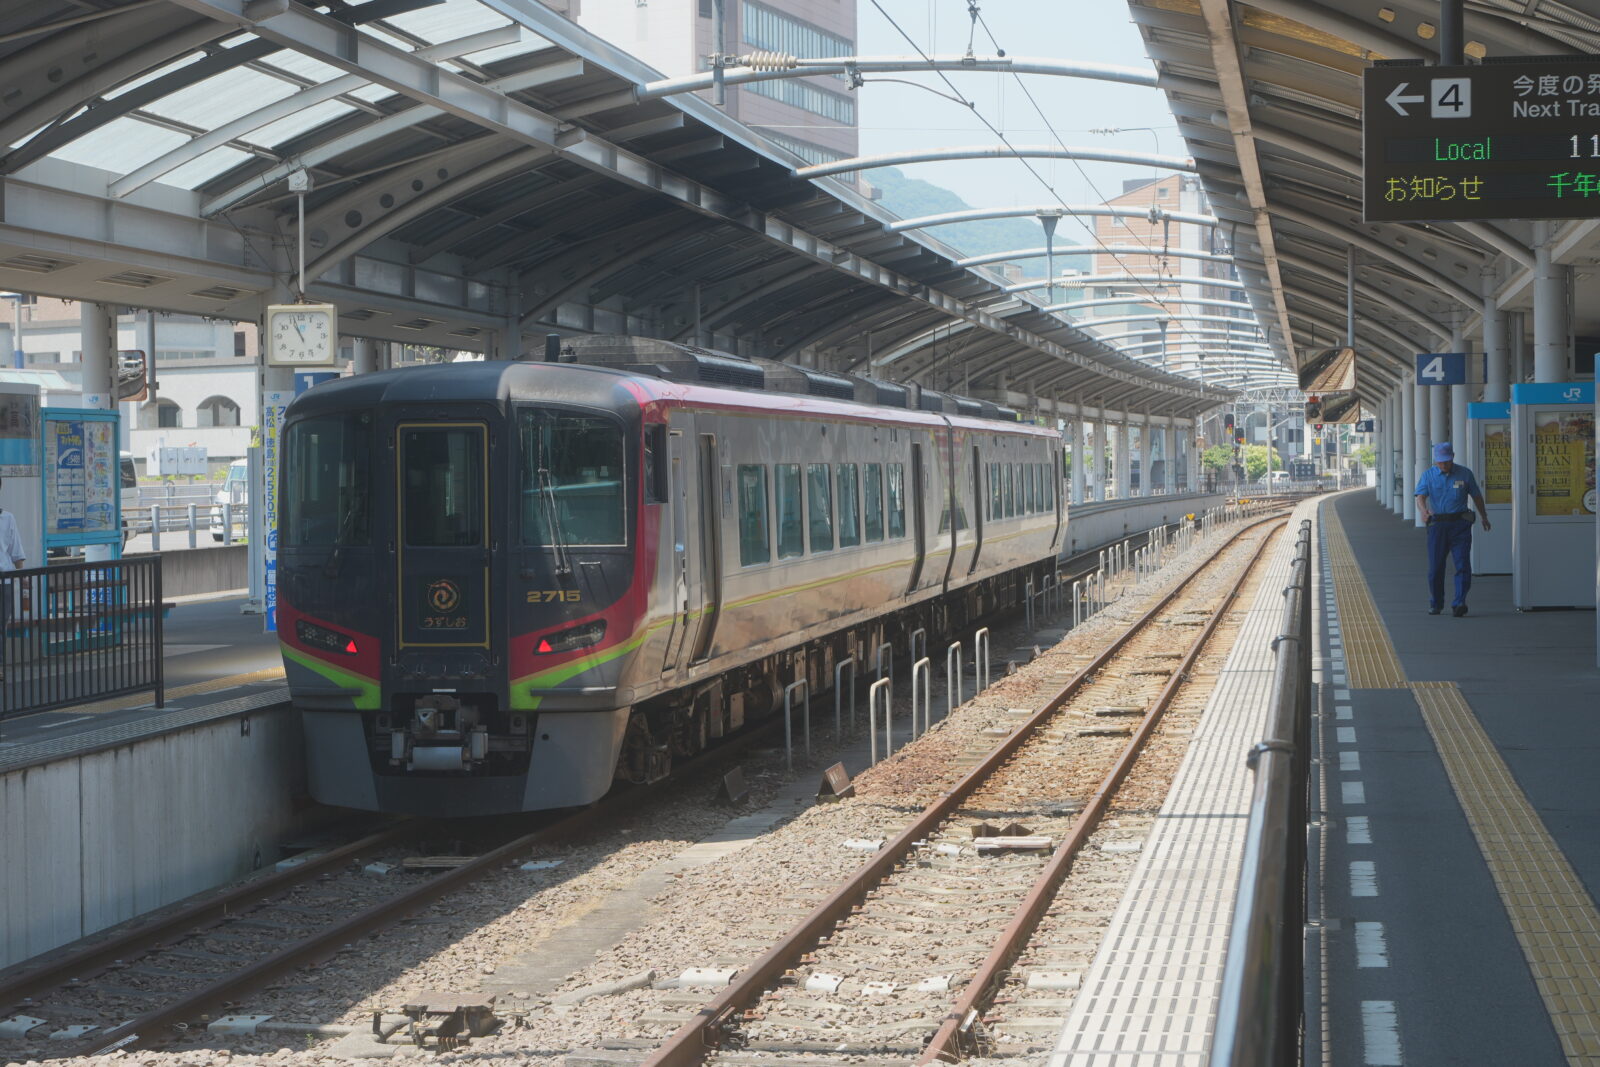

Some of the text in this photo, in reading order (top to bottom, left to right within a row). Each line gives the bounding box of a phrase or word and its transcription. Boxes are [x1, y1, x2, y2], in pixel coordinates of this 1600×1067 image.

[1438, 84, 1464, 112] 4
[1513, 100, 1560, 117] Next
[1435, 137, 1490, 160] Local
[1384, 175, 1485, 202] お知らせ
[1422, 356, 1445, 382] 4
[1563, 387, 1583, 399] JR
[1357, 421, 1366, 431] 4
[1536, 434, 1571, 445] BEER
[1536, 445, 1571, 455] HALL
[1536, 456, 1571, 466] PLAN
[527, 589, 581, 603] 2715
[424, 615, 467, 628] うずしお
